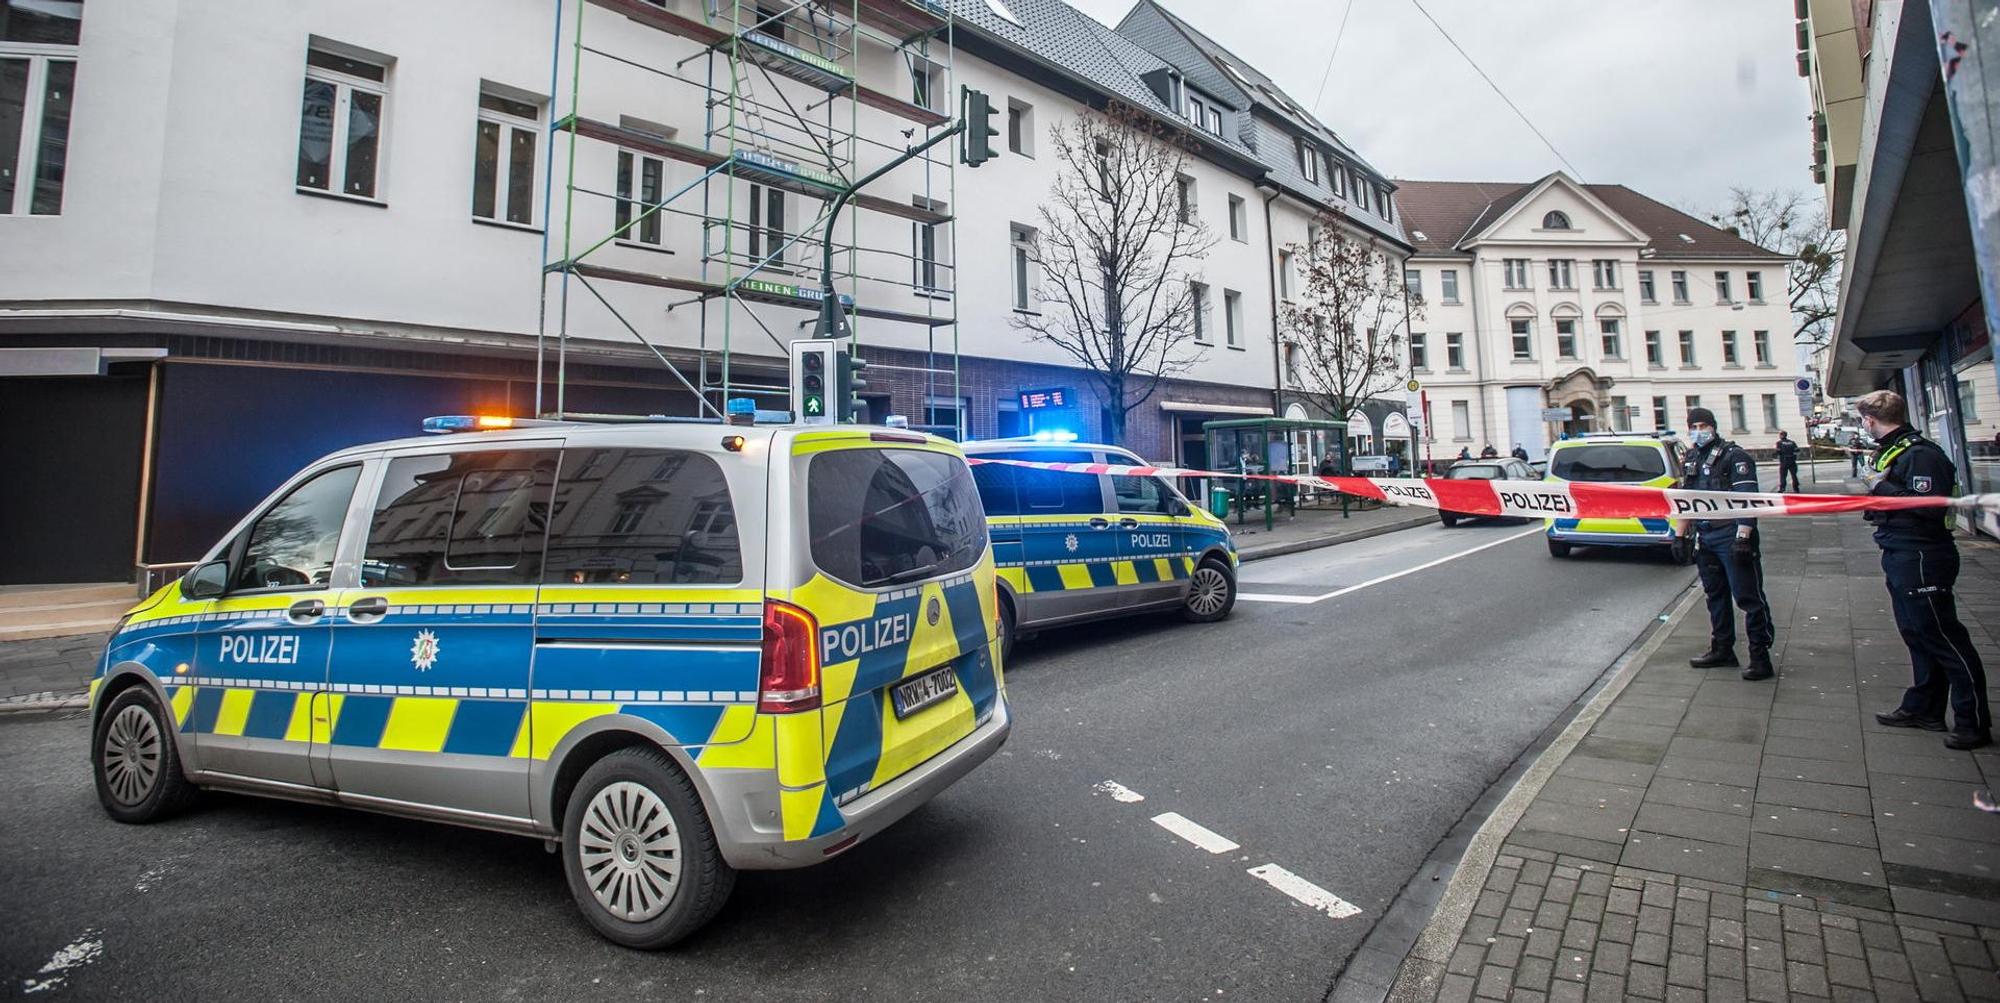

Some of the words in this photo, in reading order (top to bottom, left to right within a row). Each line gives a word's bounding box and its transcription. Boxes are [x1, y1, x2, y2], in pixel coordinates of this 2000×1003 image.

[741, 280, 846, 303] HEINEN-GRUE
[1380, 485, 1432, 500] POLIZEI
[1500, 492, 1571, 513] POLIZEI
[1131, 533, 1171, 548] POLIZEI
[822, 612, 910, 663] POLIZEI
[219, 634, 300, 665] POLIZEI
[899, 682, 921, 710] NRW
